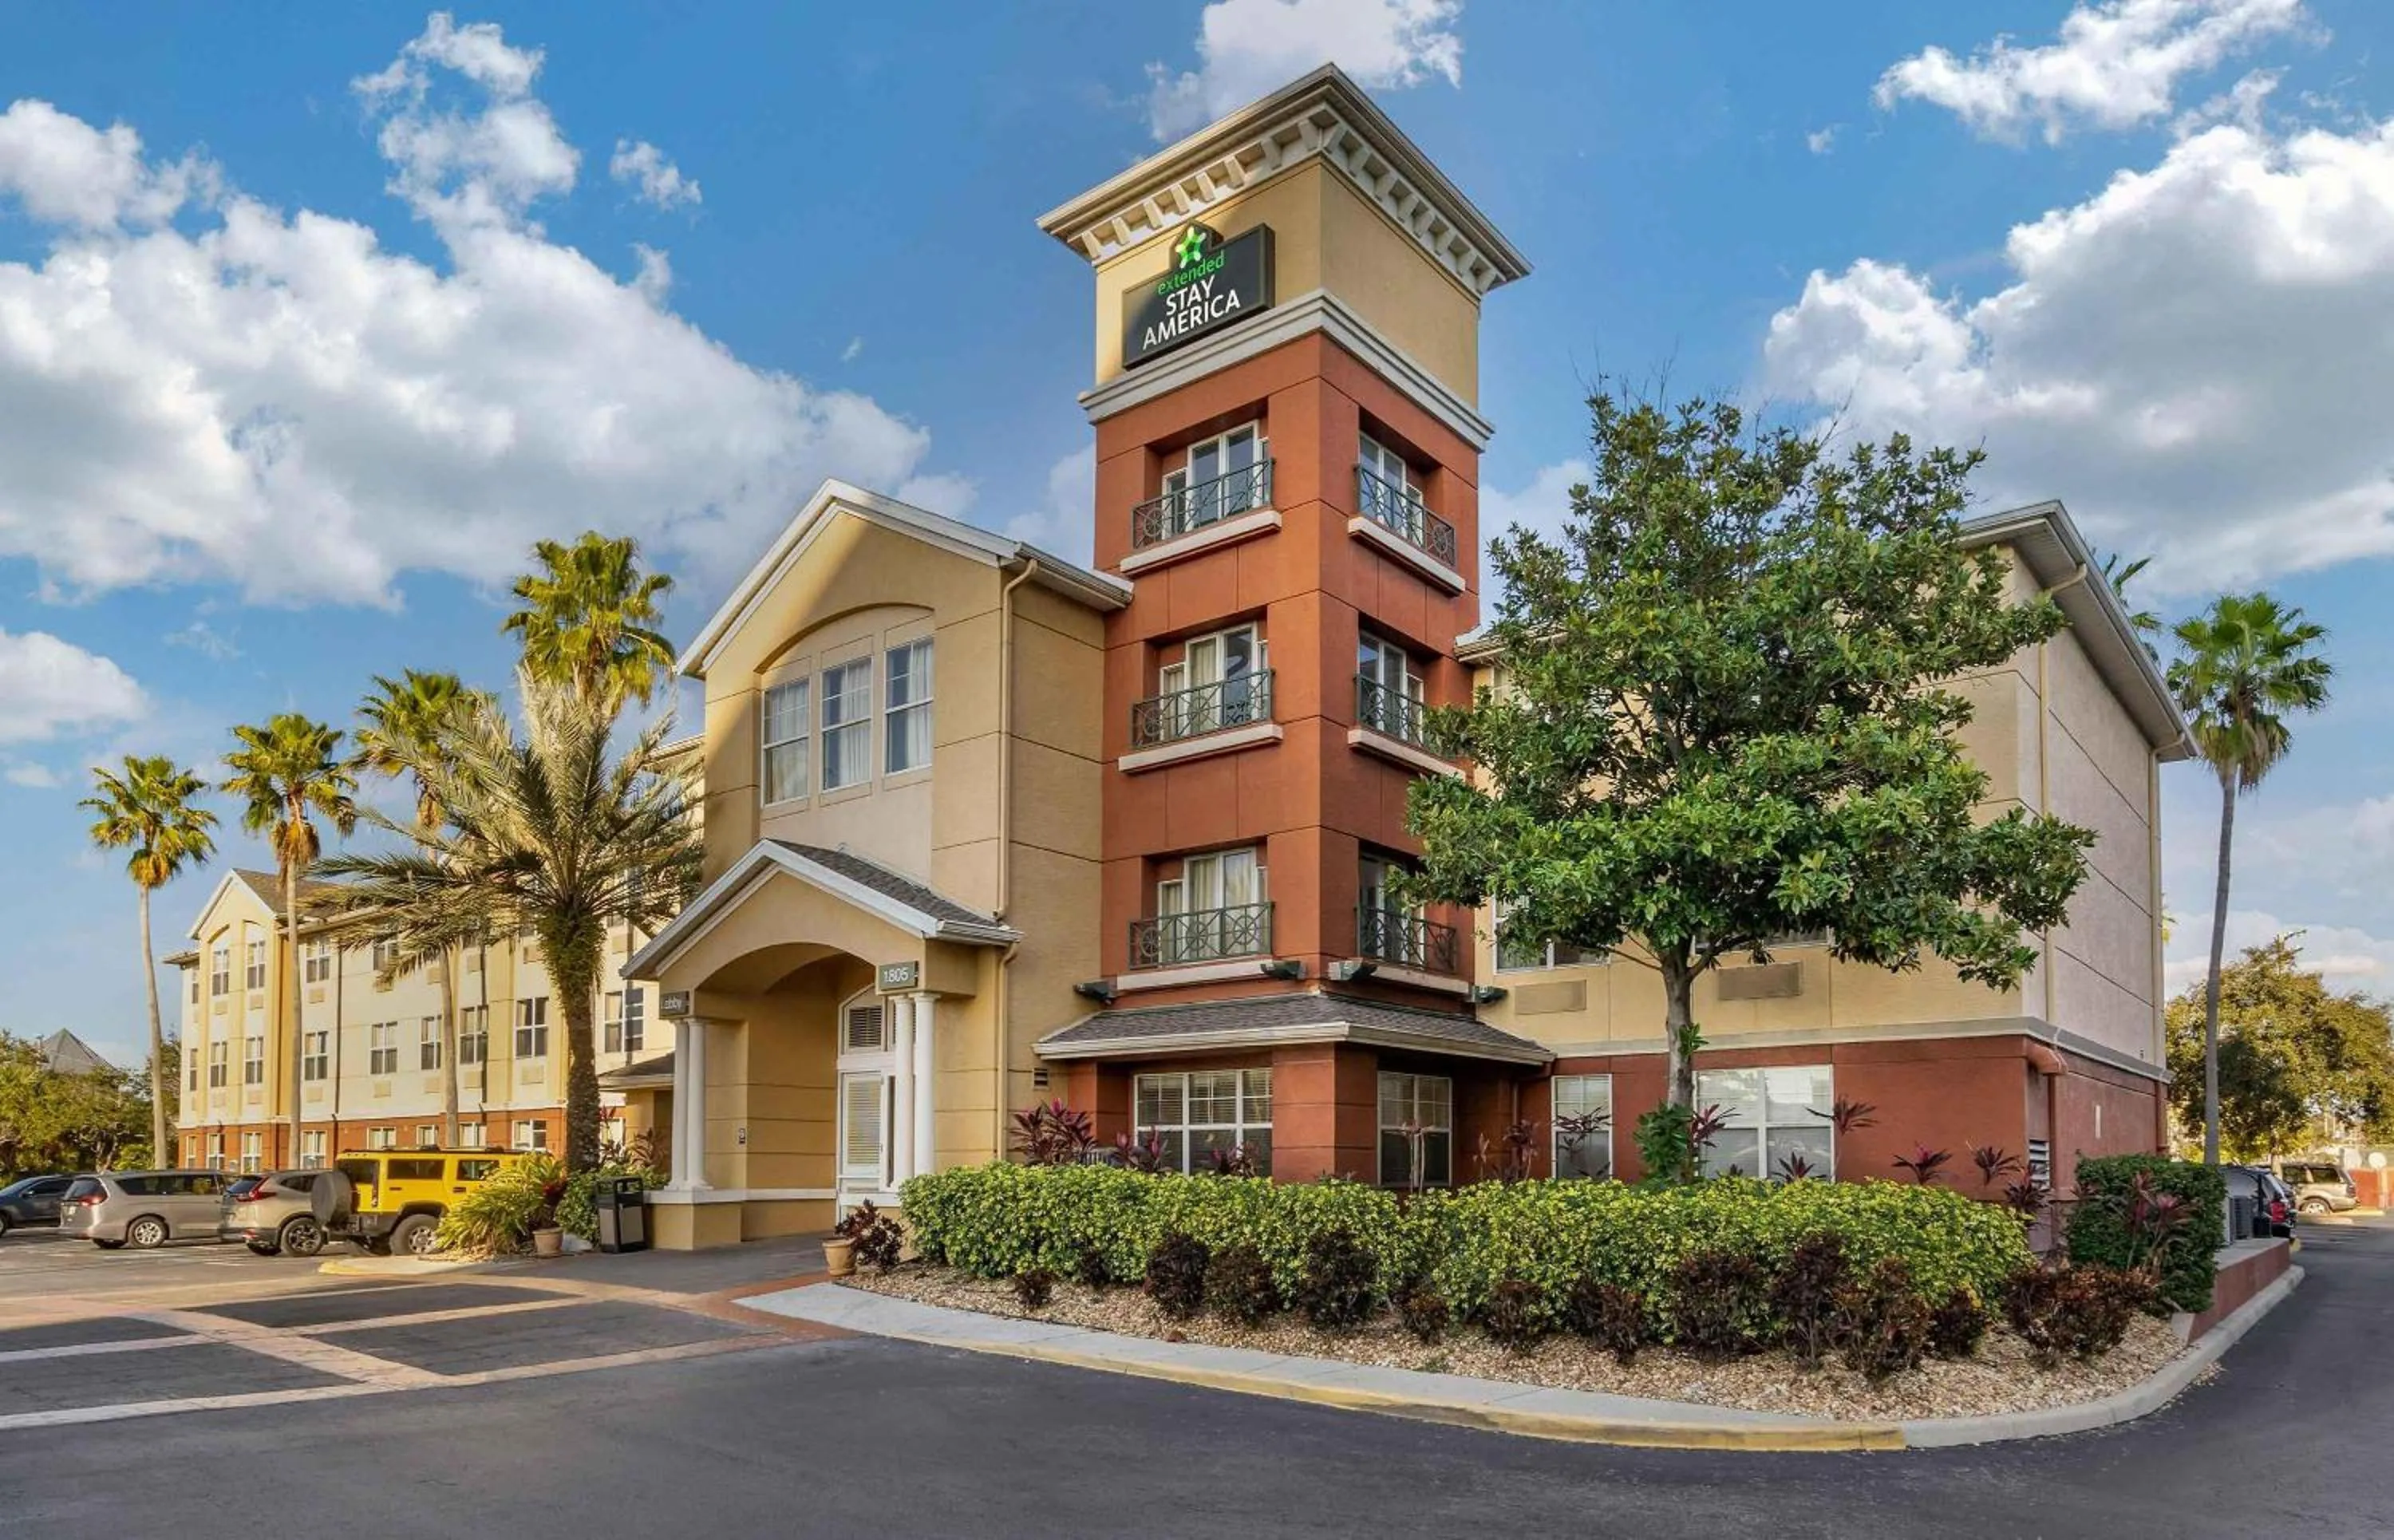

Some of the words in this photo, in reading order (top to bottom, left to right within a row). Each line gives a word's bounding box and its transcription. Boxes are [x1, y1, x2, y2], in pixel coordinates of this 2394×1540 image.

[1158, 250, 1225, 295] extended
[1166, 274, 1215, 315] STAY
[1143, 289, 1241, 349] AMERICA
[883, 966, 908, 982] 1805
